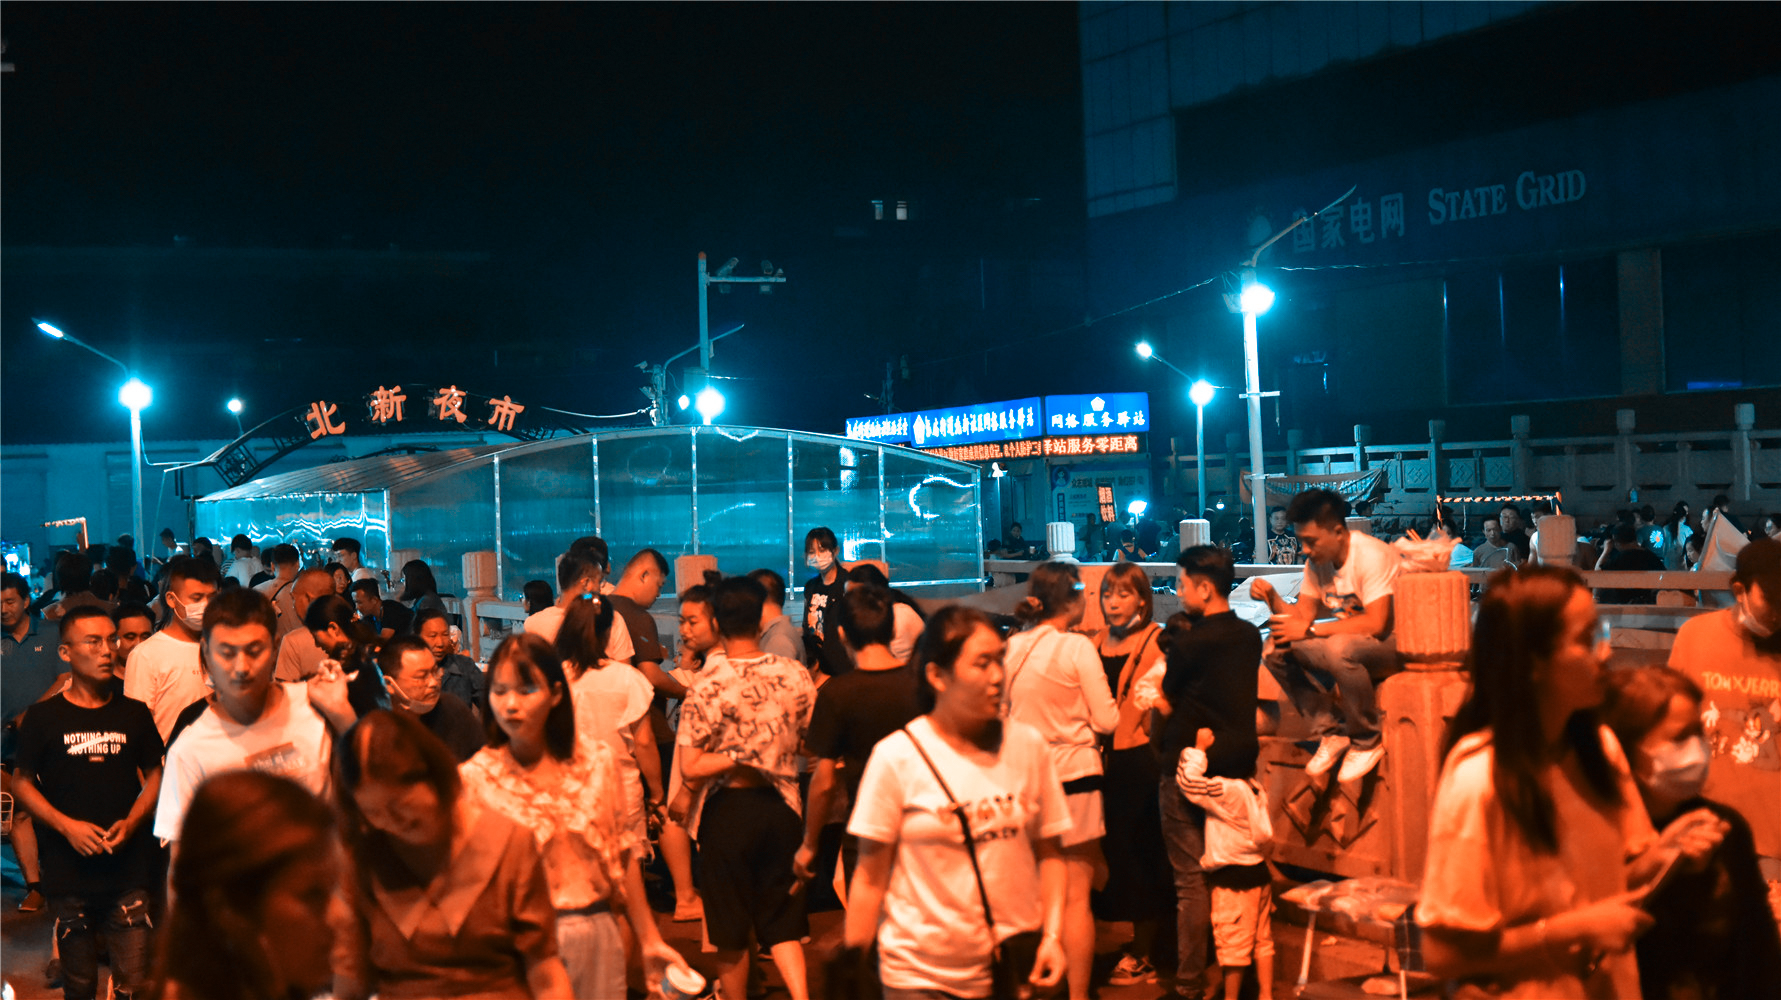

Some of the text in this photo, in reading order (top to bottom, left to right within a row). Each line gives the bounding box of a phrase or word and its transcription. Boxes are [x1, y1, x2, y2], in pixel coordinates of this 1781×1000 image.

[1428, 169, 1587, 225] STATE GRID
[1292, 192, 1406, 253] 国家电网
[306, 384, 525, 440] 北新夜市
[1051, 410, 1146, 428] 网格服务驿站
[63, 731, 102, 745] NOTHING
[110, 743, 122, 755] UP
